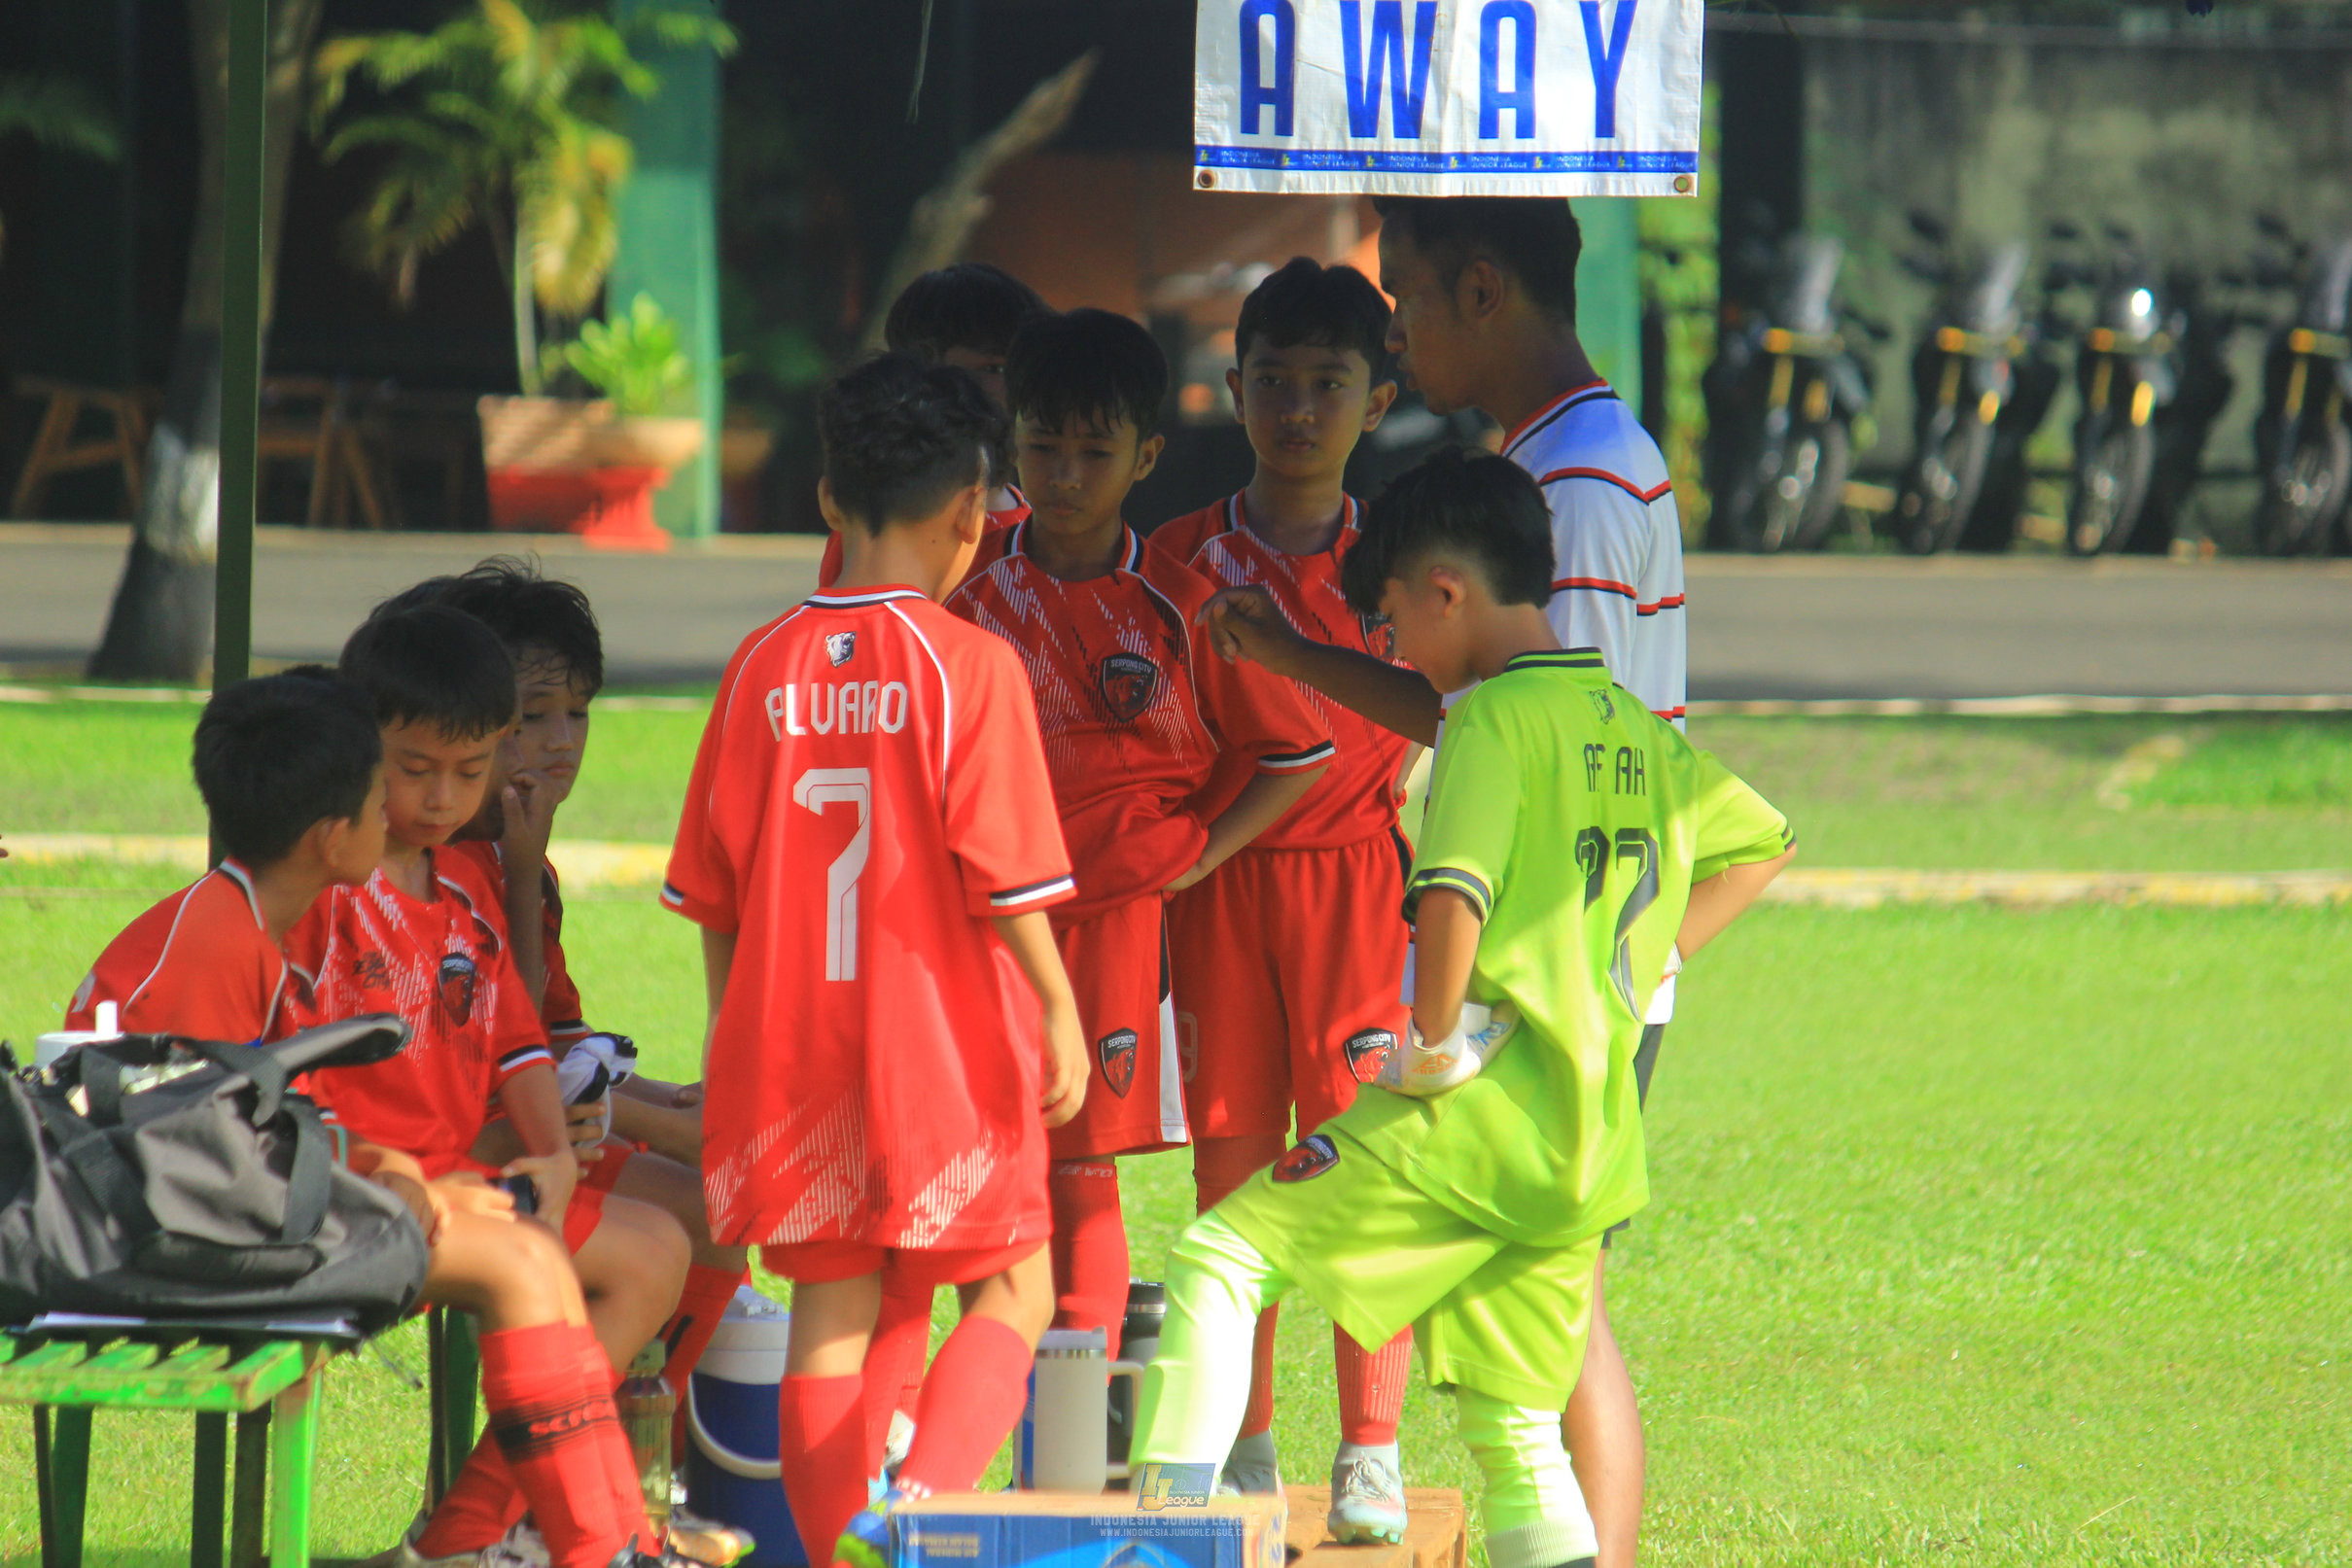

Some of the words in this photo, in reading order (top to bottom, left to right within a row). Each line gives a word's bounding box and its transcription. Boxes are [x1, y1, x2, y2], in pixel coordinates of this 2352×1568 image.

[1239, 0, 1637, 139] AWAY
[1110, 658, 1139, 669] SERPONG
[764, 679, 908, 742] ALVARO
[792, 767, 870, 982] 7
[1352, 1033, 1379, 1049] SERPONG
